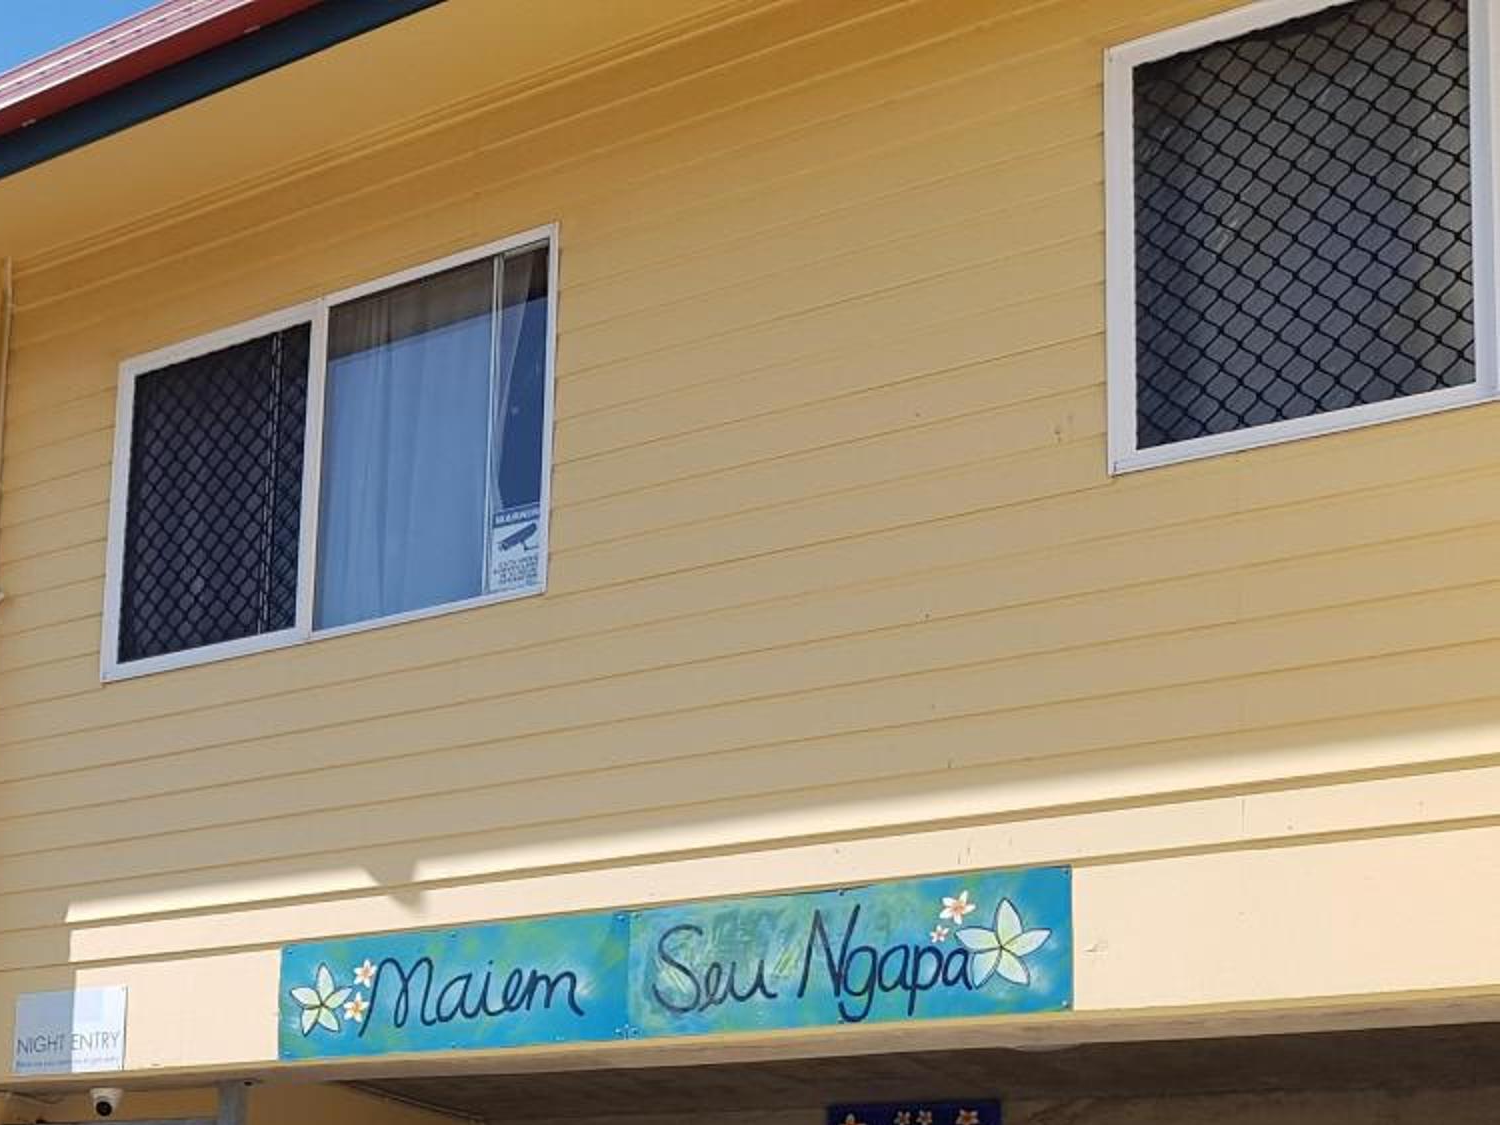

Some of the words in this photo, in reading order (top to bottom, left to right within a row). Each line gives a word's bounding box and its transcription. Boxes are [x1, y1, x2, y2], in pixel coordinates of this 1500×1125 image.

[358, 955, 585, 1038] Maiem
[652, 923, 778, 1012] Seu
[797, 903, 974, 1023] Ngapa
[17, 1033, 66, 1056] NIGHT
[69, 1030, 120, 1052] ENTRY
